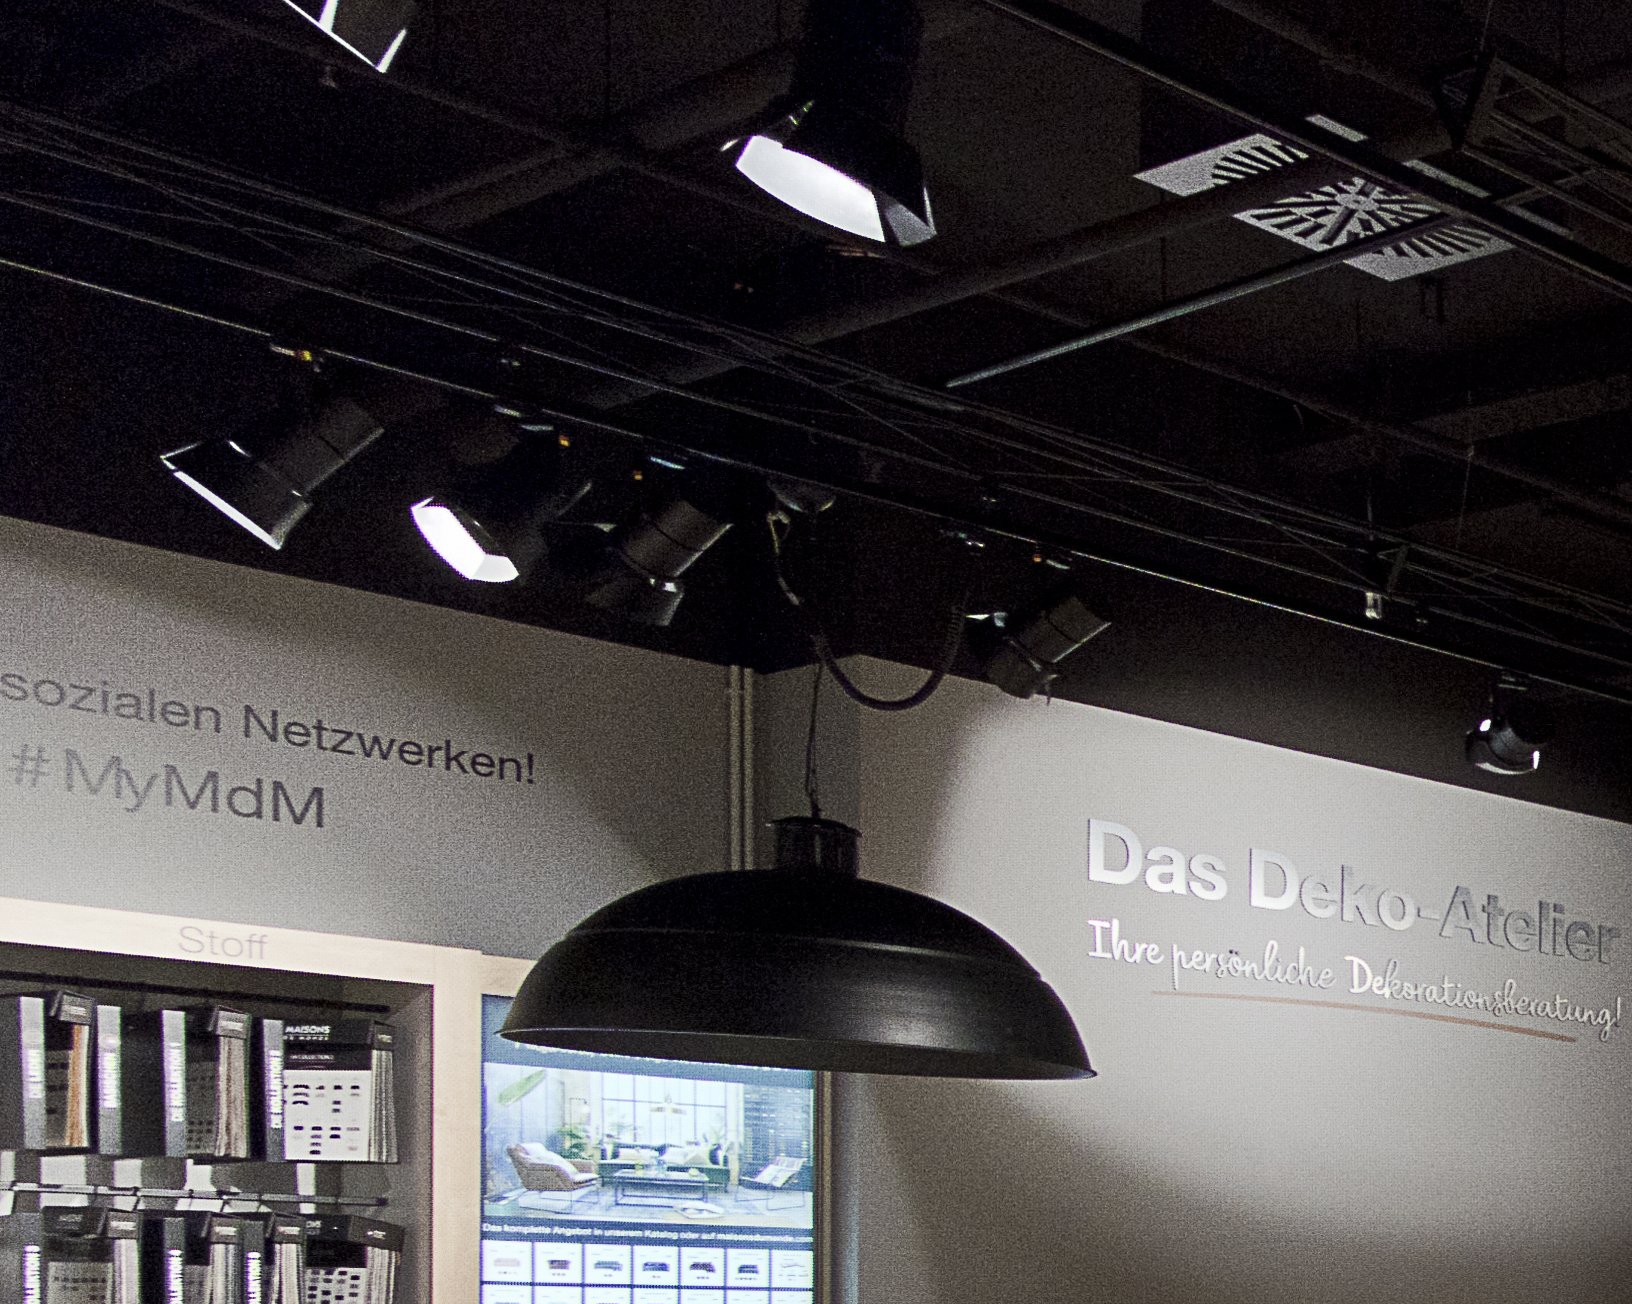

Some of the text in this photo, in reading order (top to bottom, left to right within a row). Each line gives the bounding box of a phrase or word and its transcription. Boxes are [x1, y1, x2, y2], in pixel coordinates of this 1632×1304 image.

[0, 672, 536, 786] sozialen Netzwerken!
[11, 743, 326, 830] #MyMdM
[1087, 818, 1622, 965] Das Deko-Atelier
[178, 925, 269, 961] Stoff
[1087, 919, 1622, 1041] Ihre persönliche Dekorationsberatung!
[285, 1025, 331, 1034] MAISONS
[552, 1227, 592, 1237] Angebot
[644, 1230, 679, 1240] Katalog
